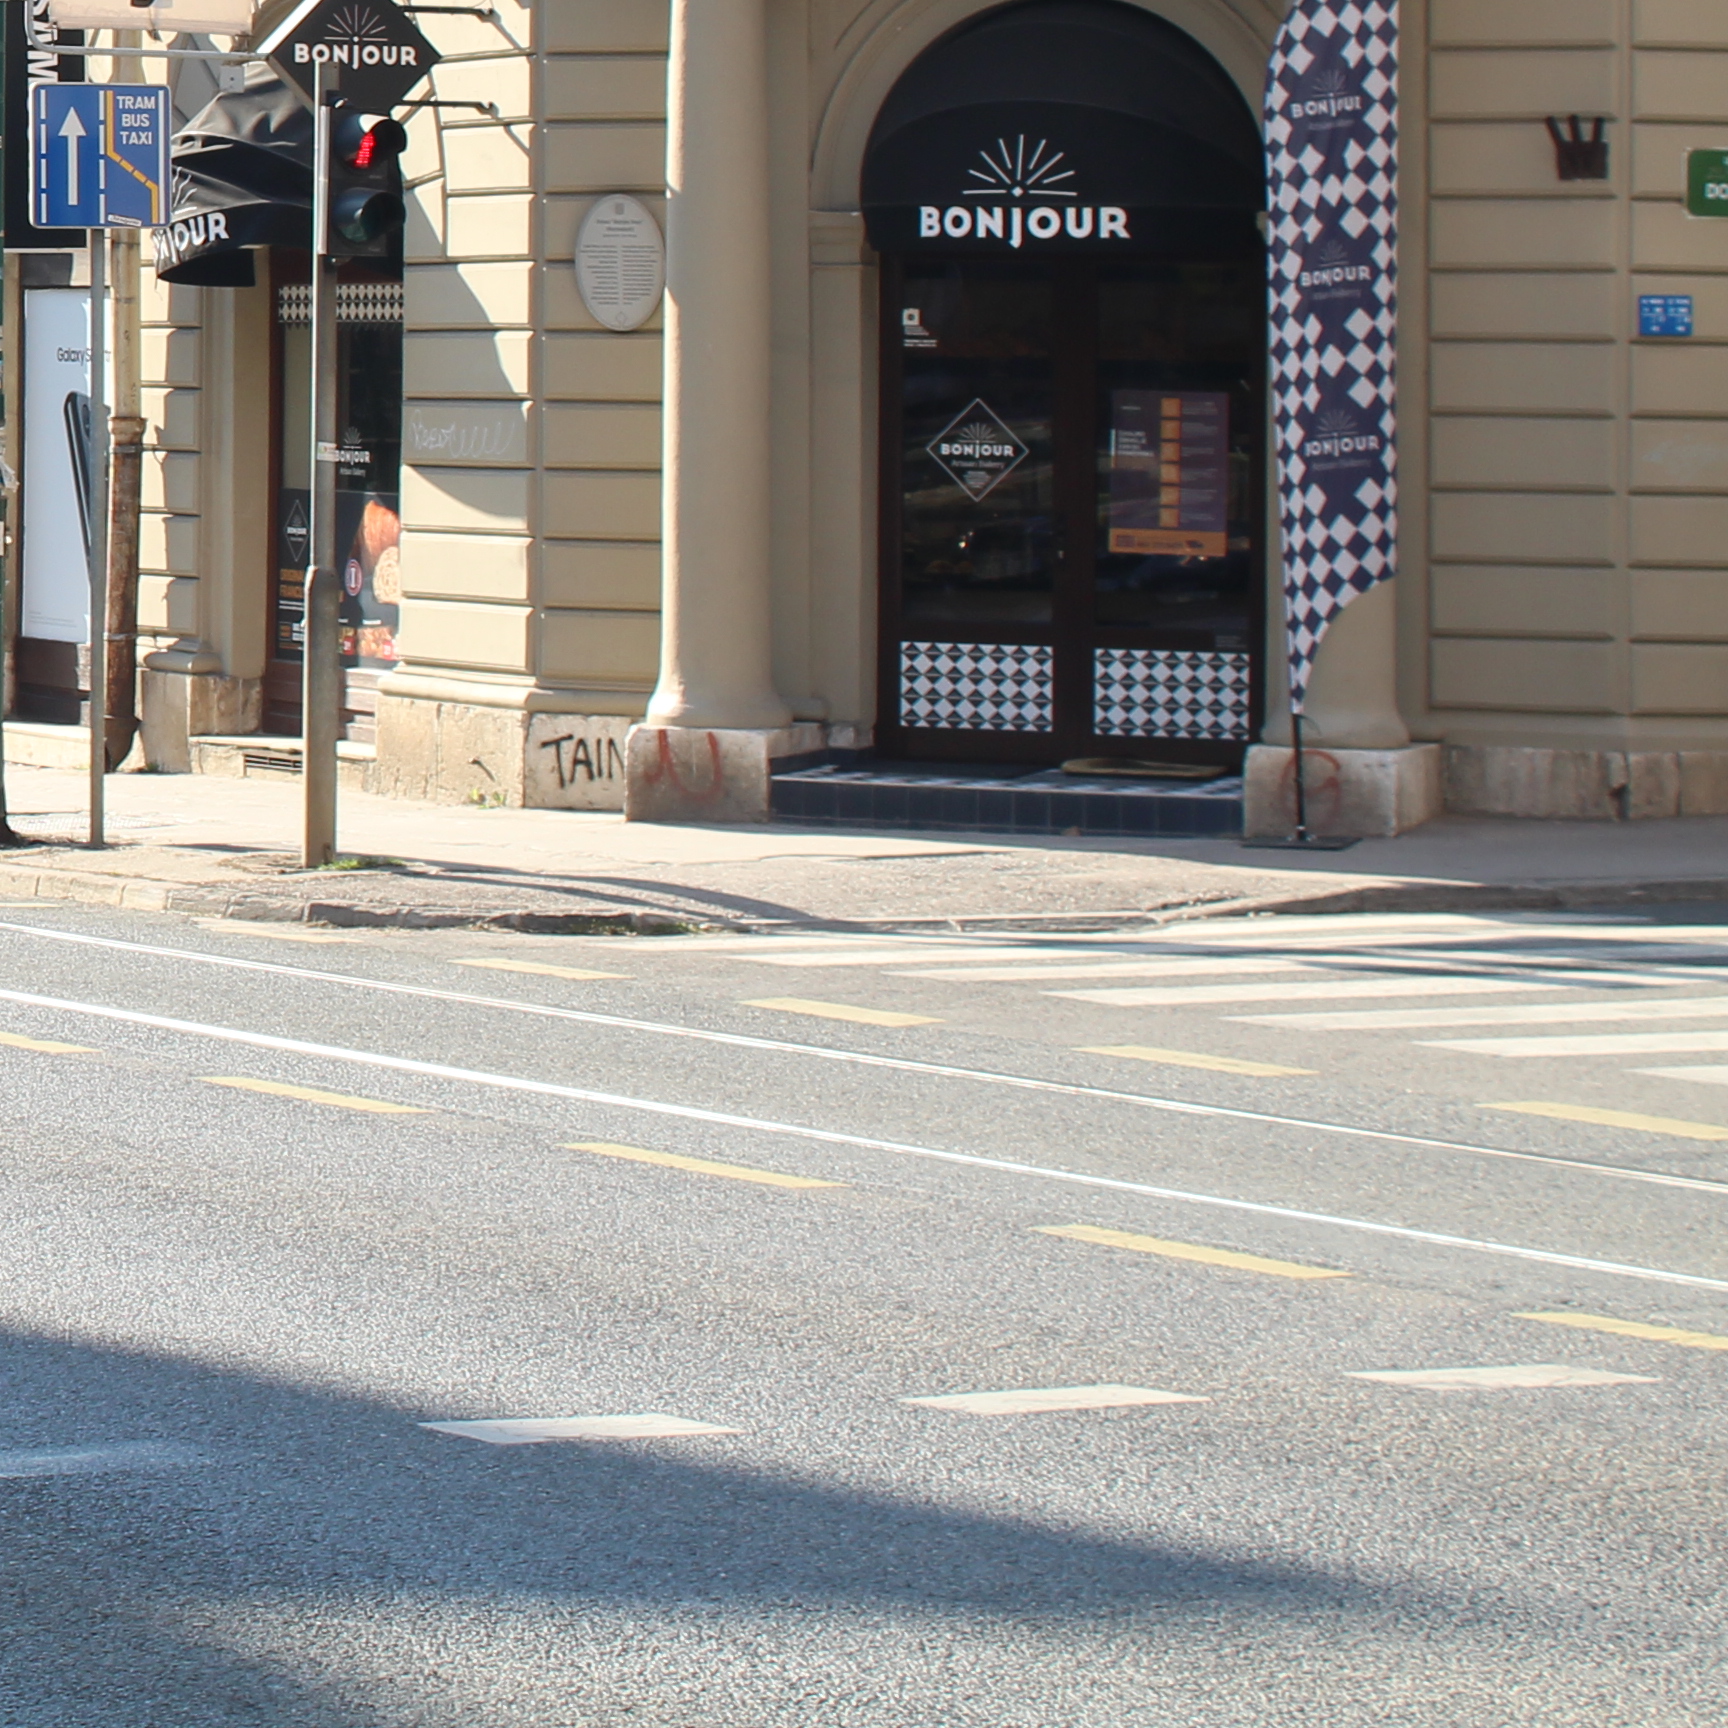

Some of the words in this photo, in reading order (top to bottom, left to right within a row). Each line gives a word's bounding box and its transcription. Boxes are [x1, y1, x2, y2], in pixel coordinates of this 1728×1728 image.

[116, 95, 156, 110] TRAM
[121, 113, 150, 127] BUS
[119, 131, 153, 145] TAXI
[56, 347, 85, 367] Galaxy
